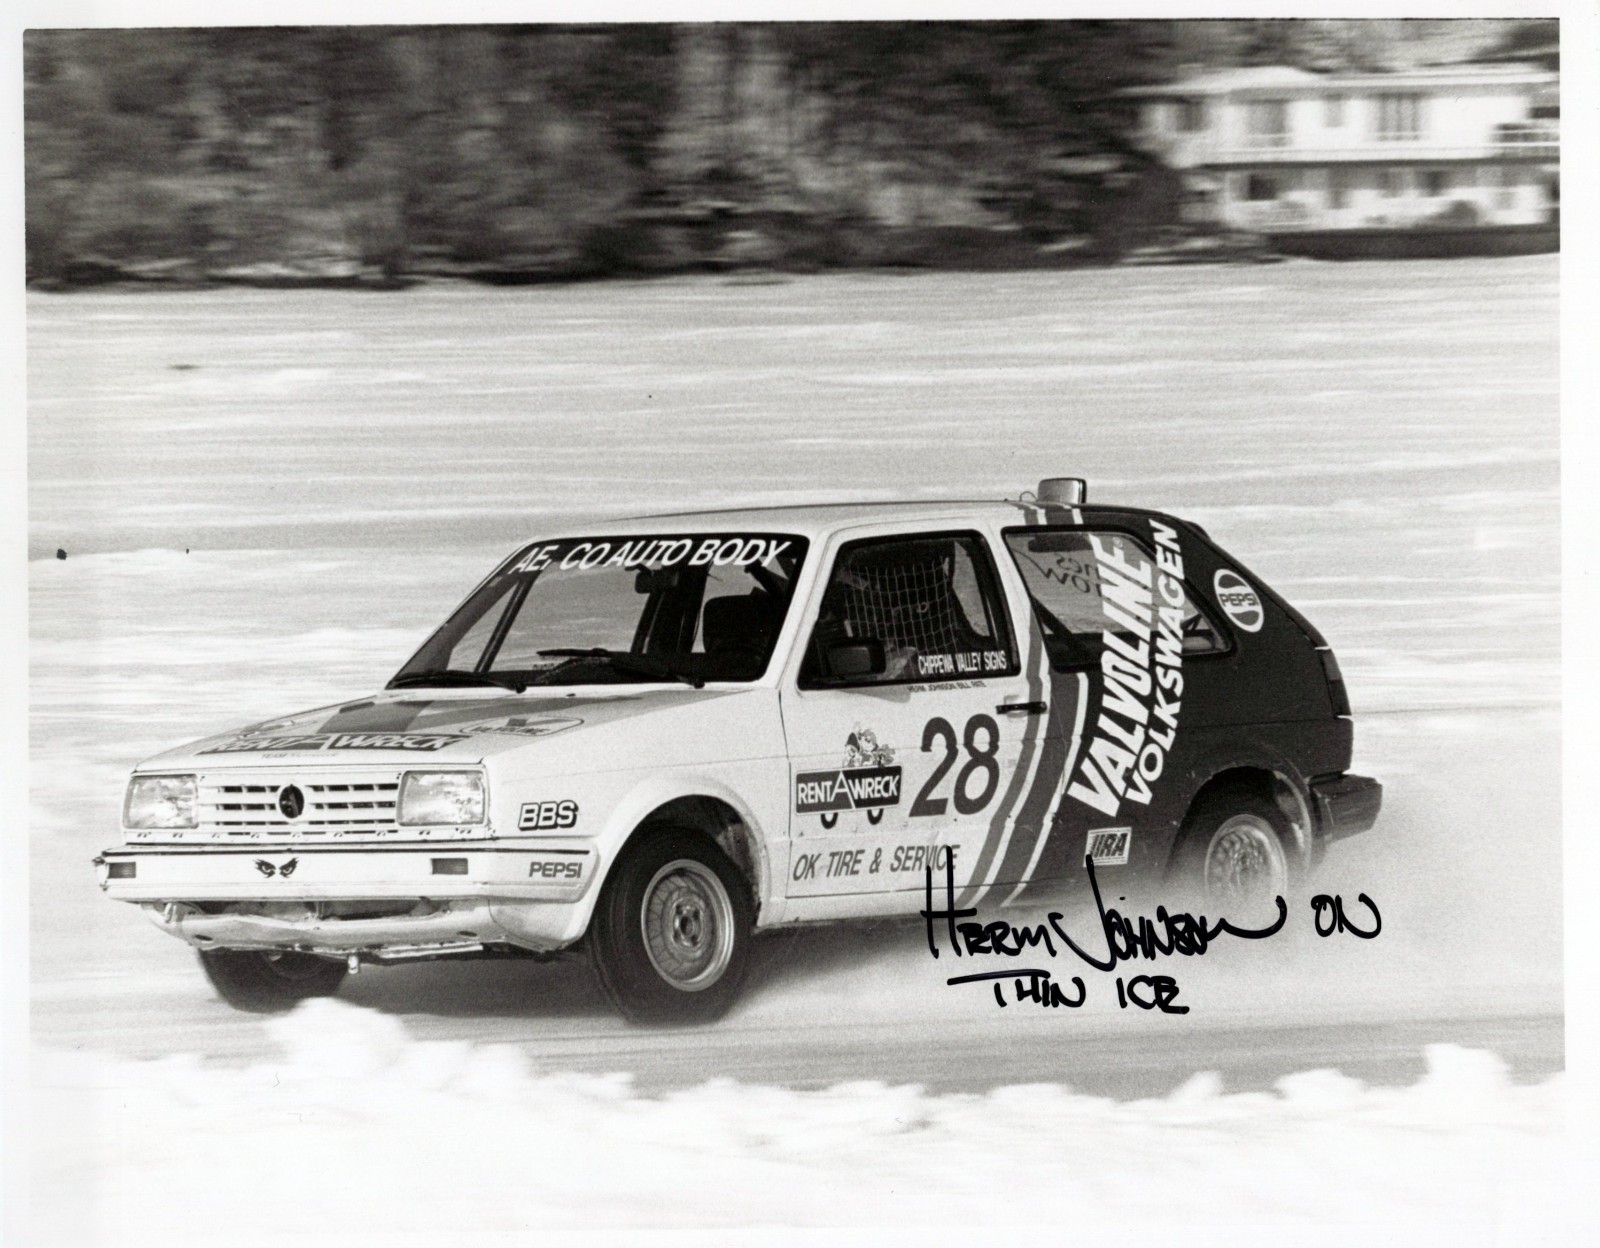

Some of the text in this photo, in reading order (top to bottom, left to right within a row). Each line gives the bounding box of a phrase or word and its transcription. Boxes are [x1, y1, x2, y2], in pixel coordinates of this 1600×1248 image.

[602, 539, 692, 567] AUTO
[688, 538, 792, 567] BODY
[1217, 593, 1259, 607] PEPSI
[918, 650, 1007, 675] CHIPPEWA VALLEY SIGNS
[1067, 534, 1152, 817] VALVOLINE
[1125, 519, 1185, 805] VOLKSWAGEN
[909, 713, 1000, 818] 28
[797, 770, 900, 809] RENT A WRECK
[518, 800, 579, 831] BBS
[529, 861, 583, 878] PEPSI
[793, 844, 961, 881] OK TIRE & SERVICE
[1311, 893, 1382, 939] ON
[947, 968, 1190, 1014] THIN ICE
